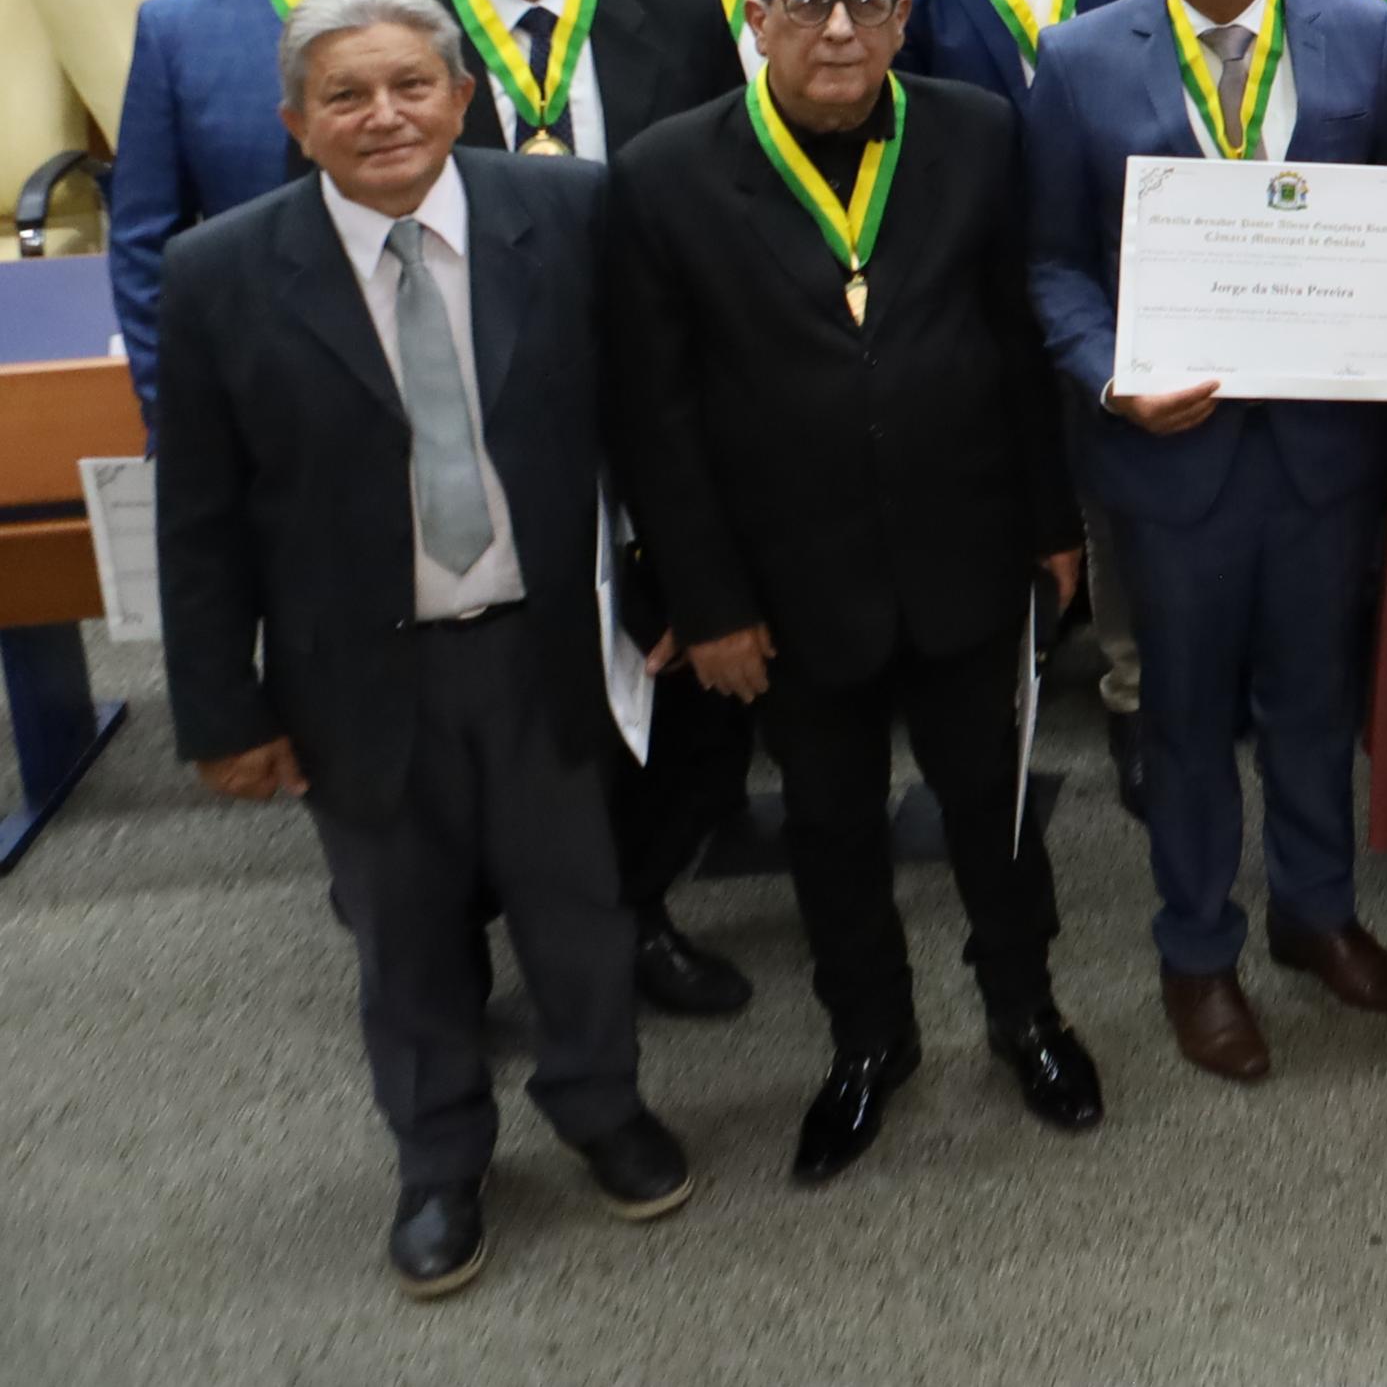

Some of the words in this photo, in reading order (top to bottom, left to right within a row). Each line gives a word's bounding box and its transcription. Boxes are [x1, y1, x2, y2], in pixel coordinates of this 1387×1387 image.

[1210, 281, 1248, 296] Jorge
[1251, 282, 1267, 295] da
[1271, 283, 1303, 296] Silva
[1307, 285, 1354, 298] Pereira
